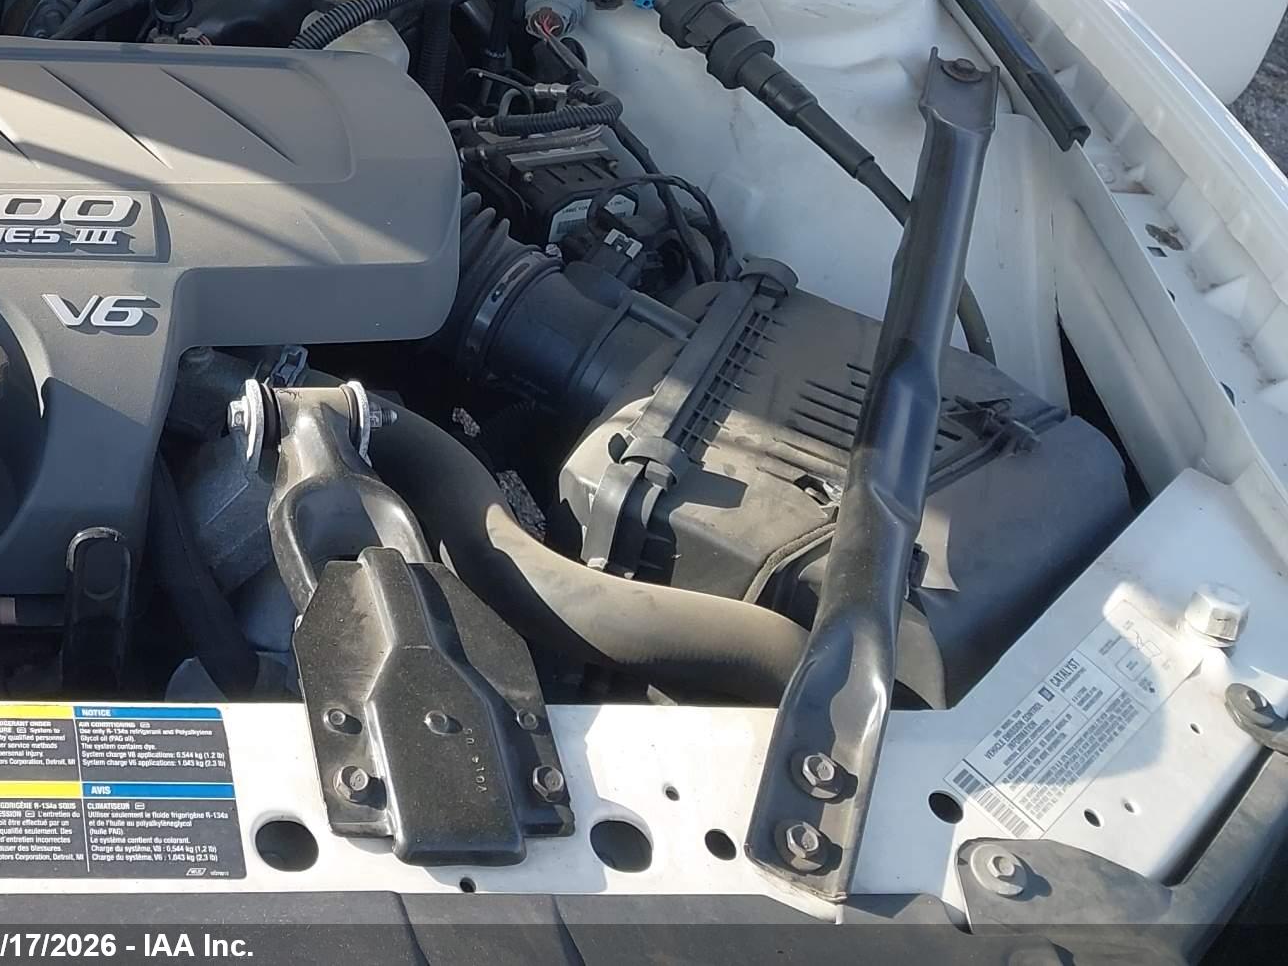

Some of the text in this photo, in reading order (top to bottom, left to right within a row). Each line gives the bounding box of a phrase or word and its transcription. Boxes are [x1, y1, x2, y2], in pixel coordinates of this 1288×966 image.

[42, 293, 148, 327] V6
[1049, 658, 1080, 688] CATALYST
[82, 750, 104, 758] System
[106, 751, 126, 759] charge
[82, 759, 105, 767] System
[107, 759, 127, 767] charge
[91, 786, 111, 794] AVIS
[91, 845, 113, 853] Charge
[186, 854, 195, 862] kg
